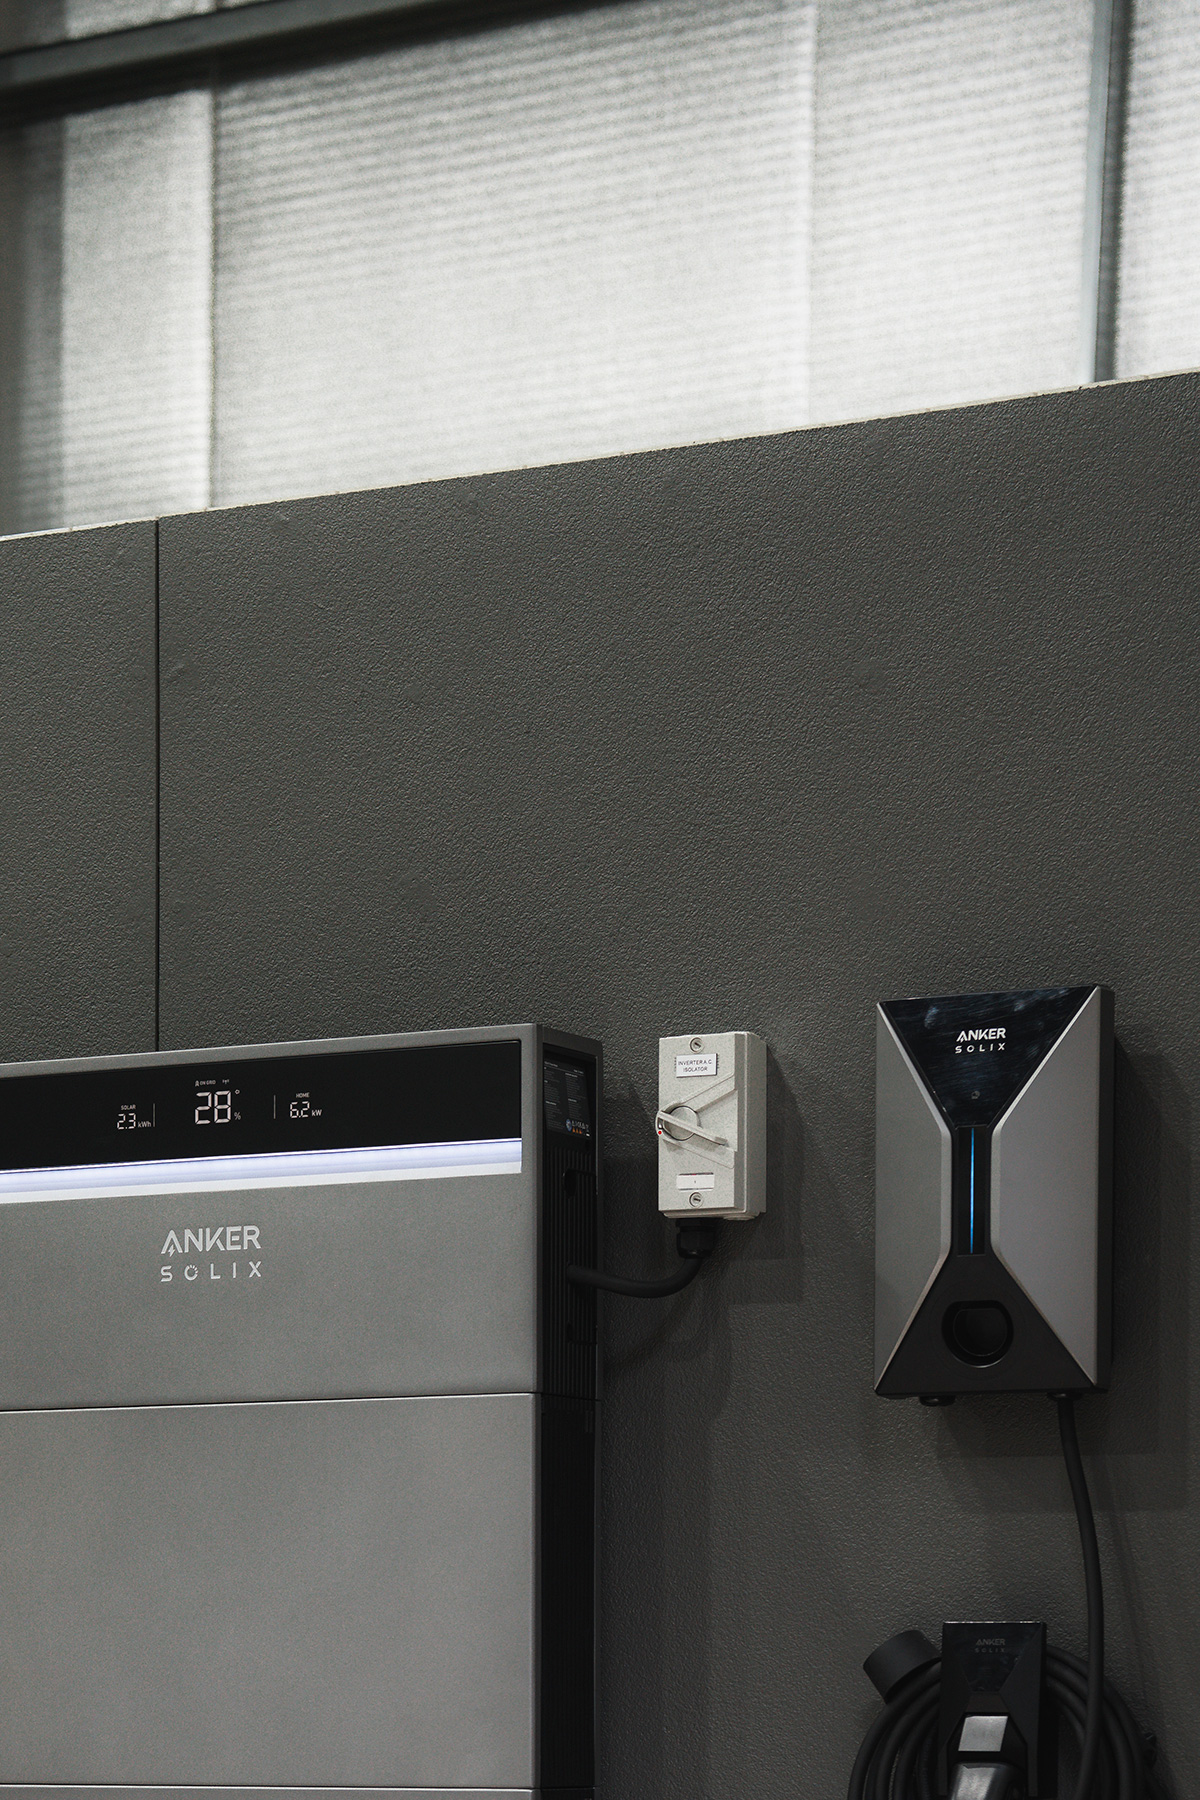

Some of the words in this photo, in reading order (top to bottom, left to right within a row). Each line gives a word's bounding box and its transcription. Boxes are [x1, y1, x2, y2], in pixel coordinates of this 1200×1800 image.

[956, 1028, 1006, 1043] ANKER
[955, 1042, 1005, 1054] SOLIX
[290, 1101, 310, 1118] 6.2
[117, 1113, 136, 1130] 2.3
[161, 1225, 261, 1257] ANKER
[160, 1261, 261, 1282] SOLIX
